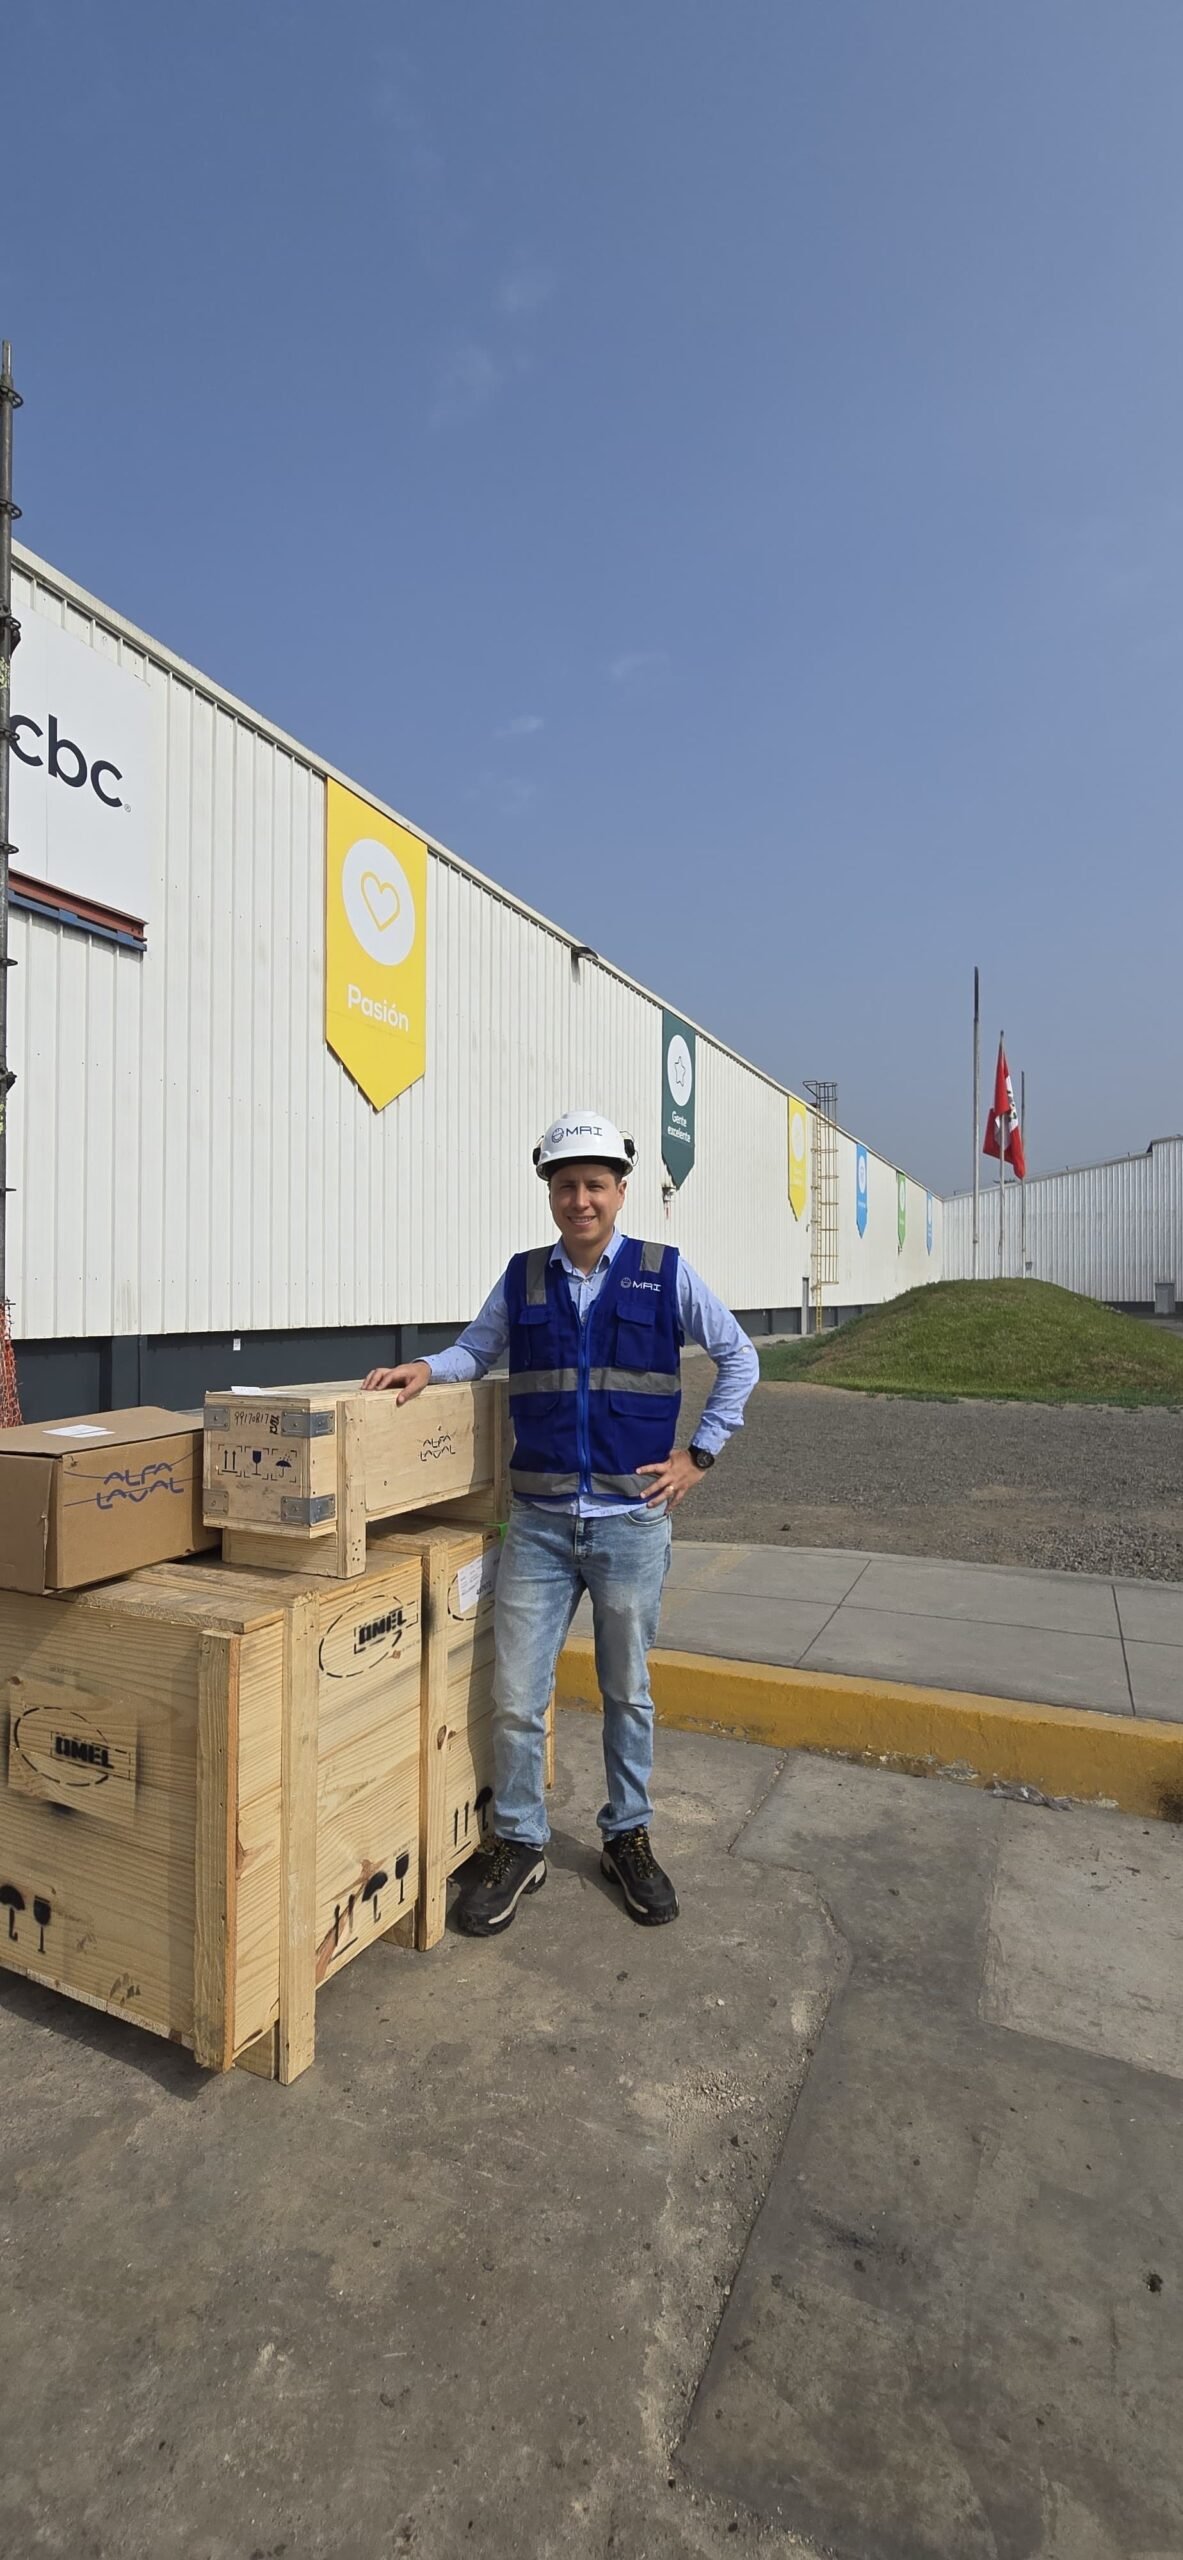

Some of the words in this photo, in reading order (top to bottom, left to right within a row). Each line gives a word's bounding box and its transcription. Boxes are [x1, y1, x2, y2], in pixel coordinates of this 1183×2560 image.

[9, 714, 122, 808] cbc
[347, 983, 409, 1033] Pasión
[672, 1111, 687, 1128] Gente
[667, 1126, 691, 1143] excelente
[423, 1435, 451, 1449] ALFA
[420, 1445, 456, 1462] LAVAL
[104, 1462, 173, 1486] ALFA
[96, 1477, 185, 1509] LAVAL
